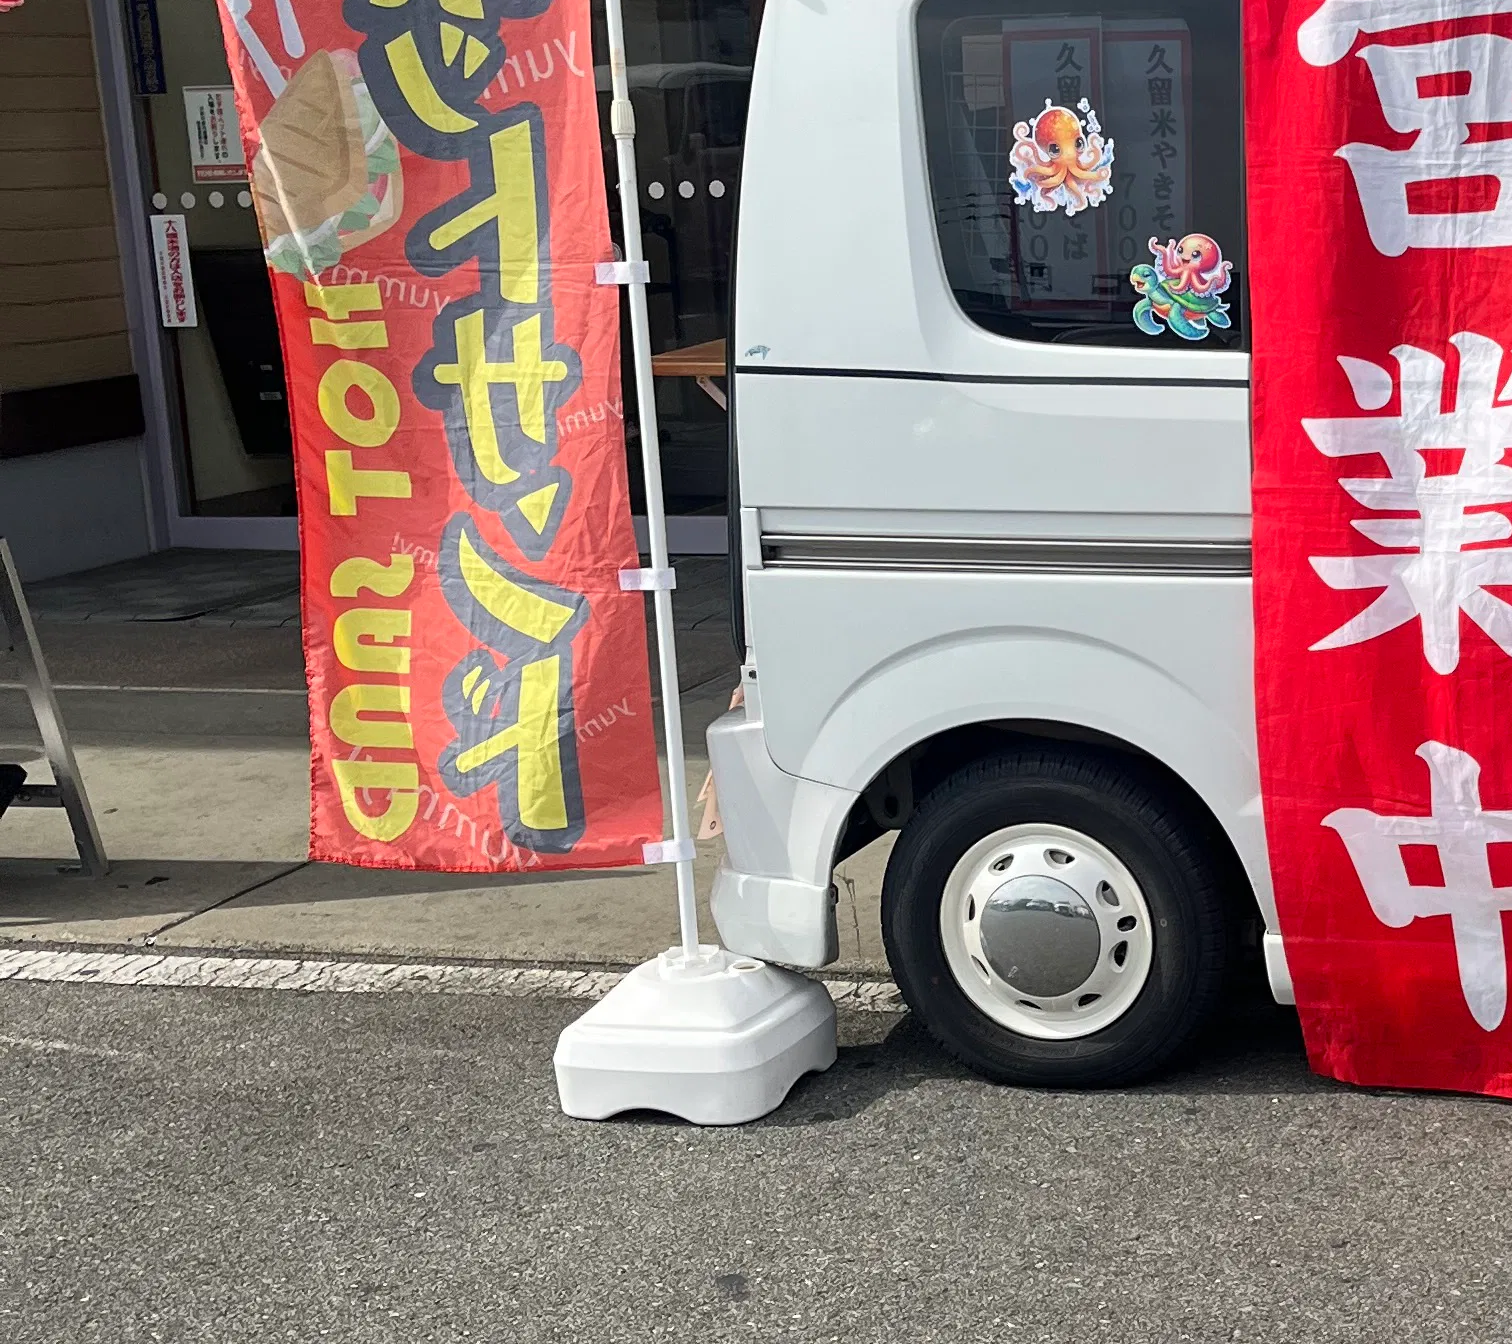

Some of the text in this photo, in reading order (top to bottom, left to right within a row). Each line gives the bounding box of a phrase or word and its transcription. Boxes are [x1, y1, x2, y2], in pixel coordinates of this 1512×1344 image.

[1145, 42, 1180, 233] 久留米やきそ
